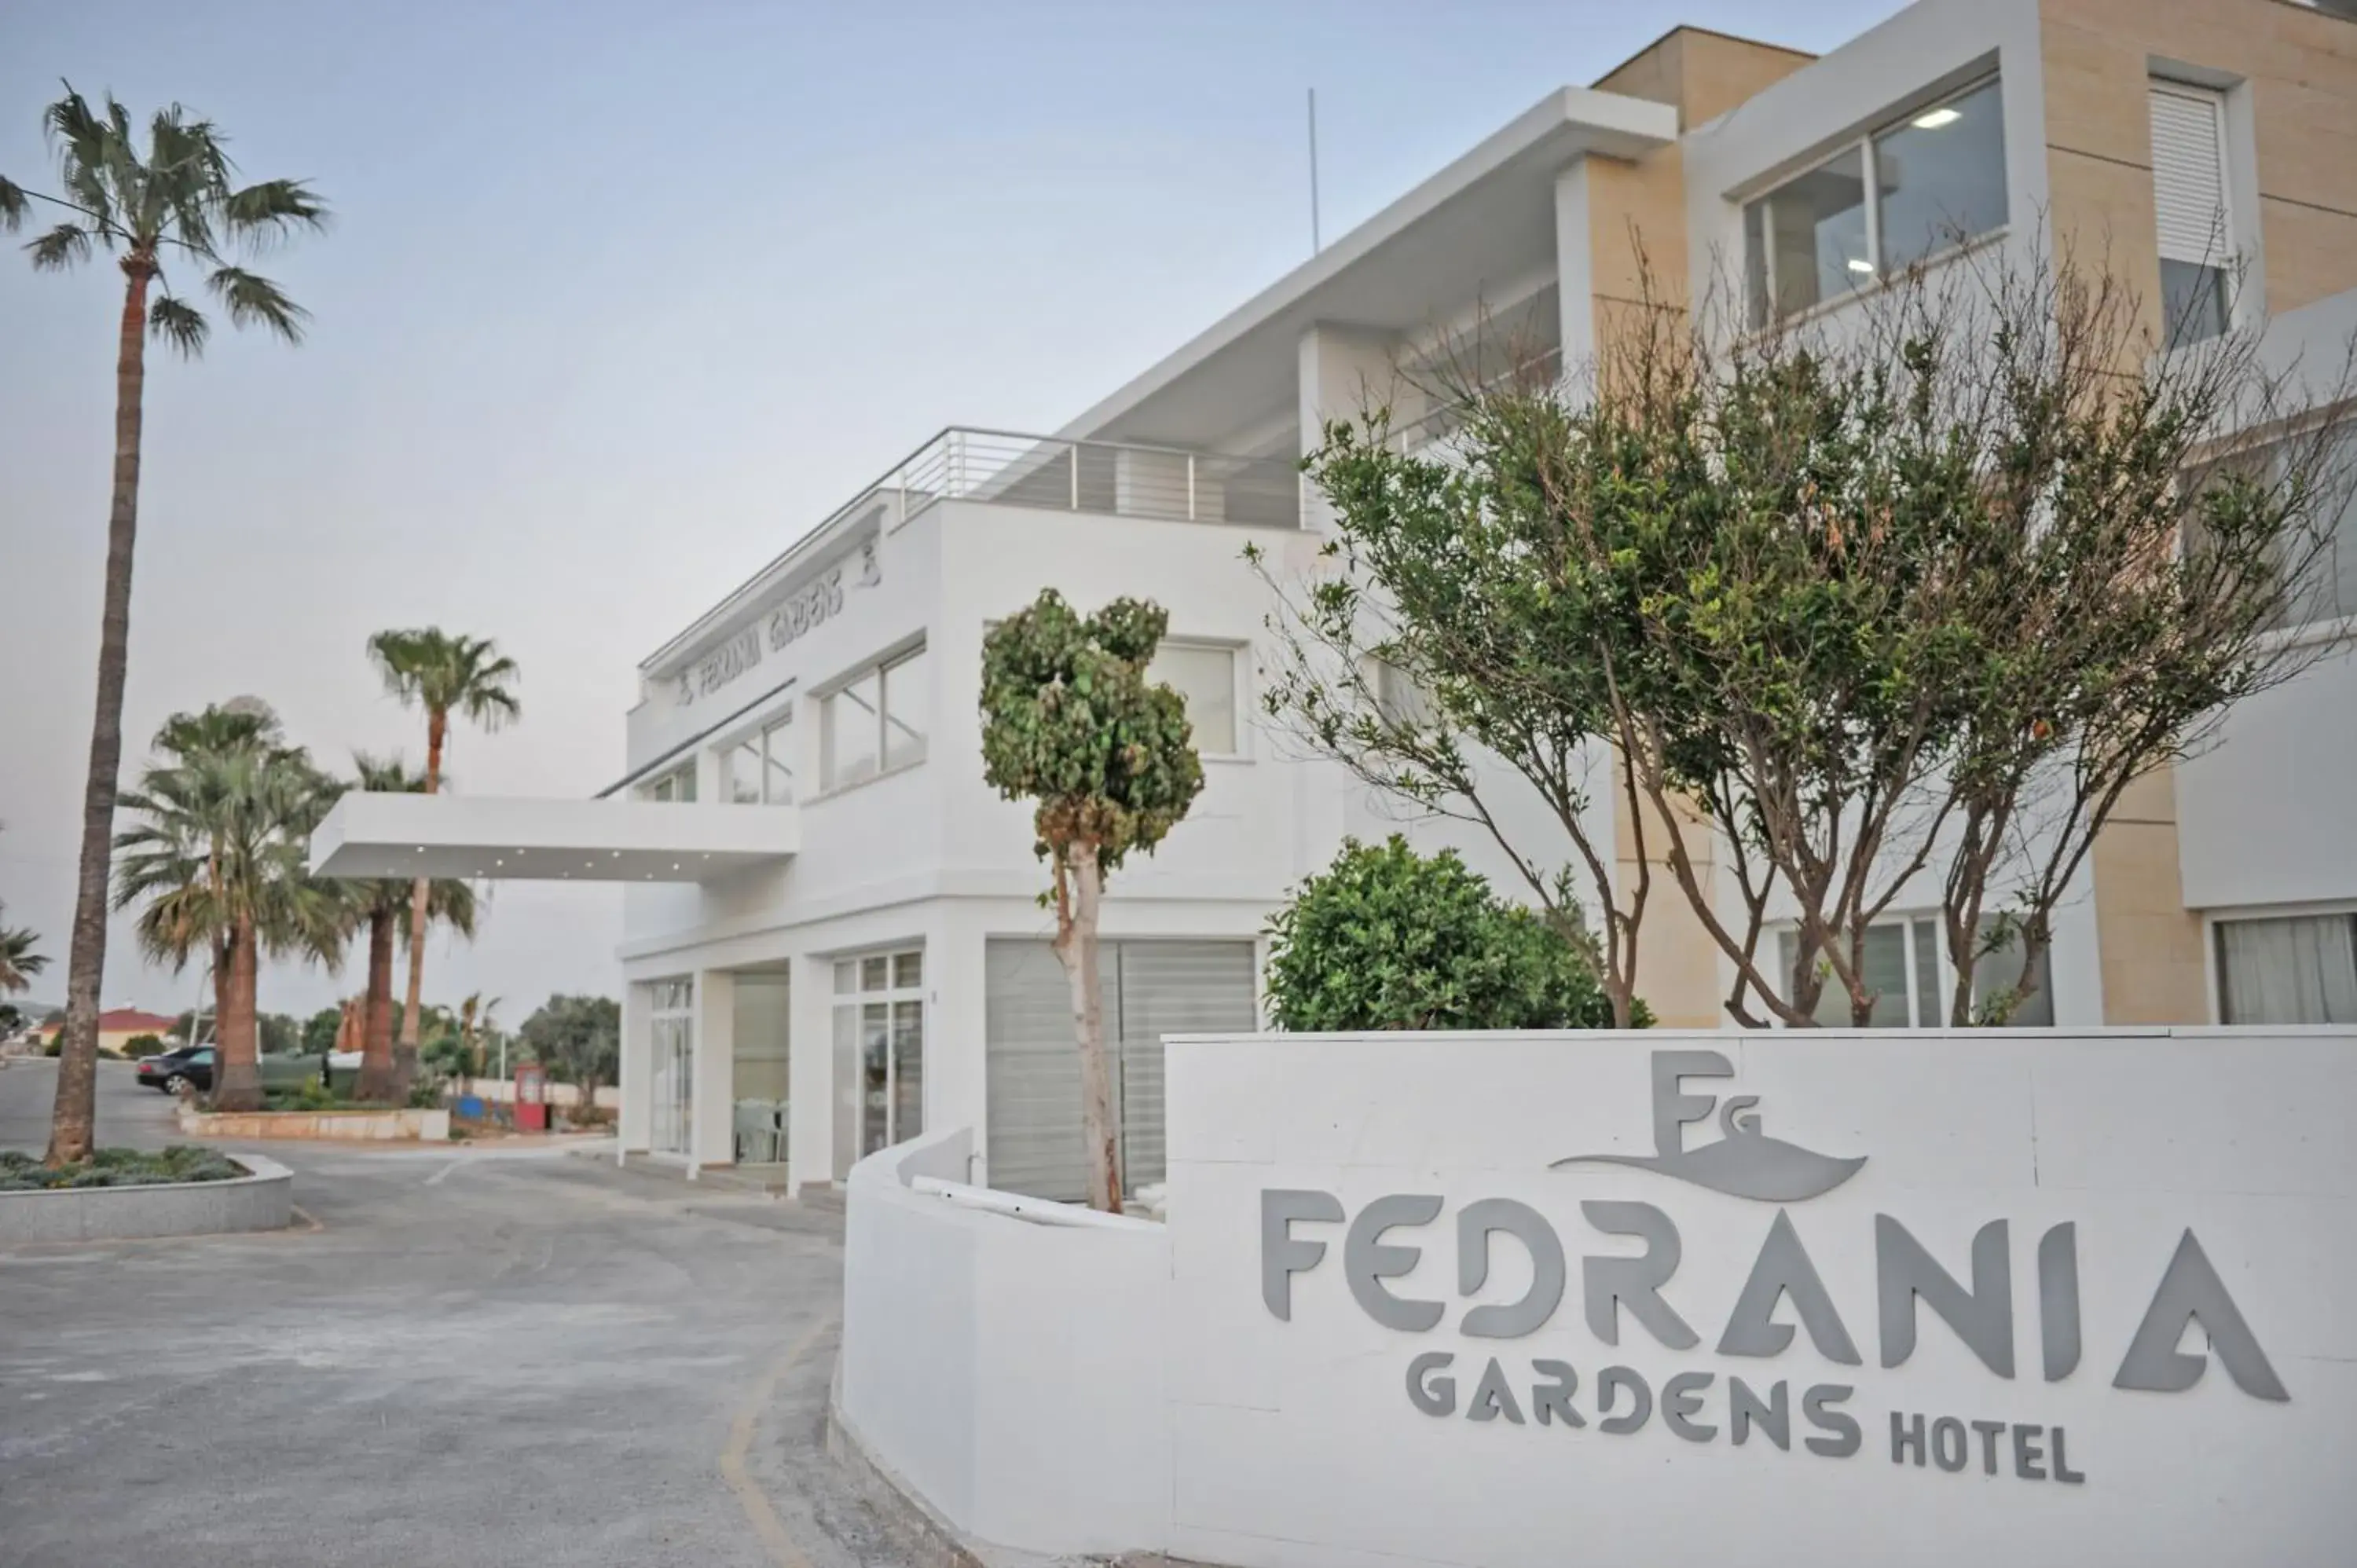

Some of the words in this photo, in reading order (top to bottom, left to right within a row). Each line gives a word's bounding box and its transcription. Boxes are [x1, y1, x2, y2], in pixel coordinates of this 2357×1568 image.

[1260, 1189, 2293, 1407] FEDRANIA
[1406, 1352, 1863, 1460] GARDENS
[1890, 1410, 2087, 1484] HOTEL
